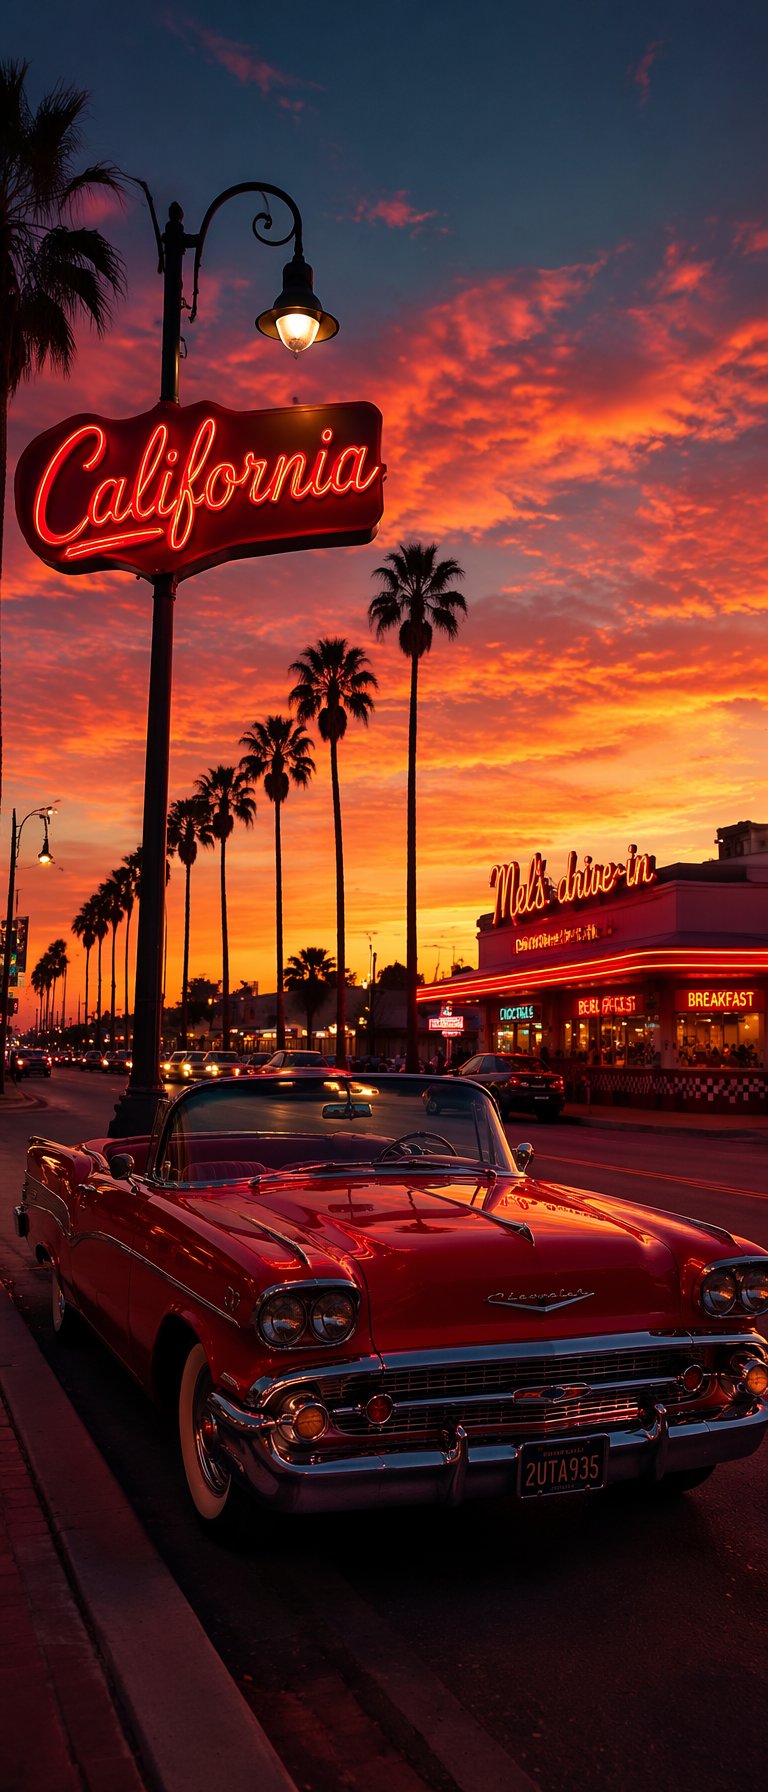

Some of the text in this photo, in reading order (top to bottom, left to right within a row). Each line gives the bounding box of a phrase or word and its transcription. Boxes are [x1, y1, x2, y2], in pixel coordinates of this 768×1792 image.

[33, 417, 381, 551] California
[489, 844, 656, 927] Mel's drive-in
[687, 991, 754, 1007] BREAKFAST
[525, 1454, 600, 1488] 2UTA935
